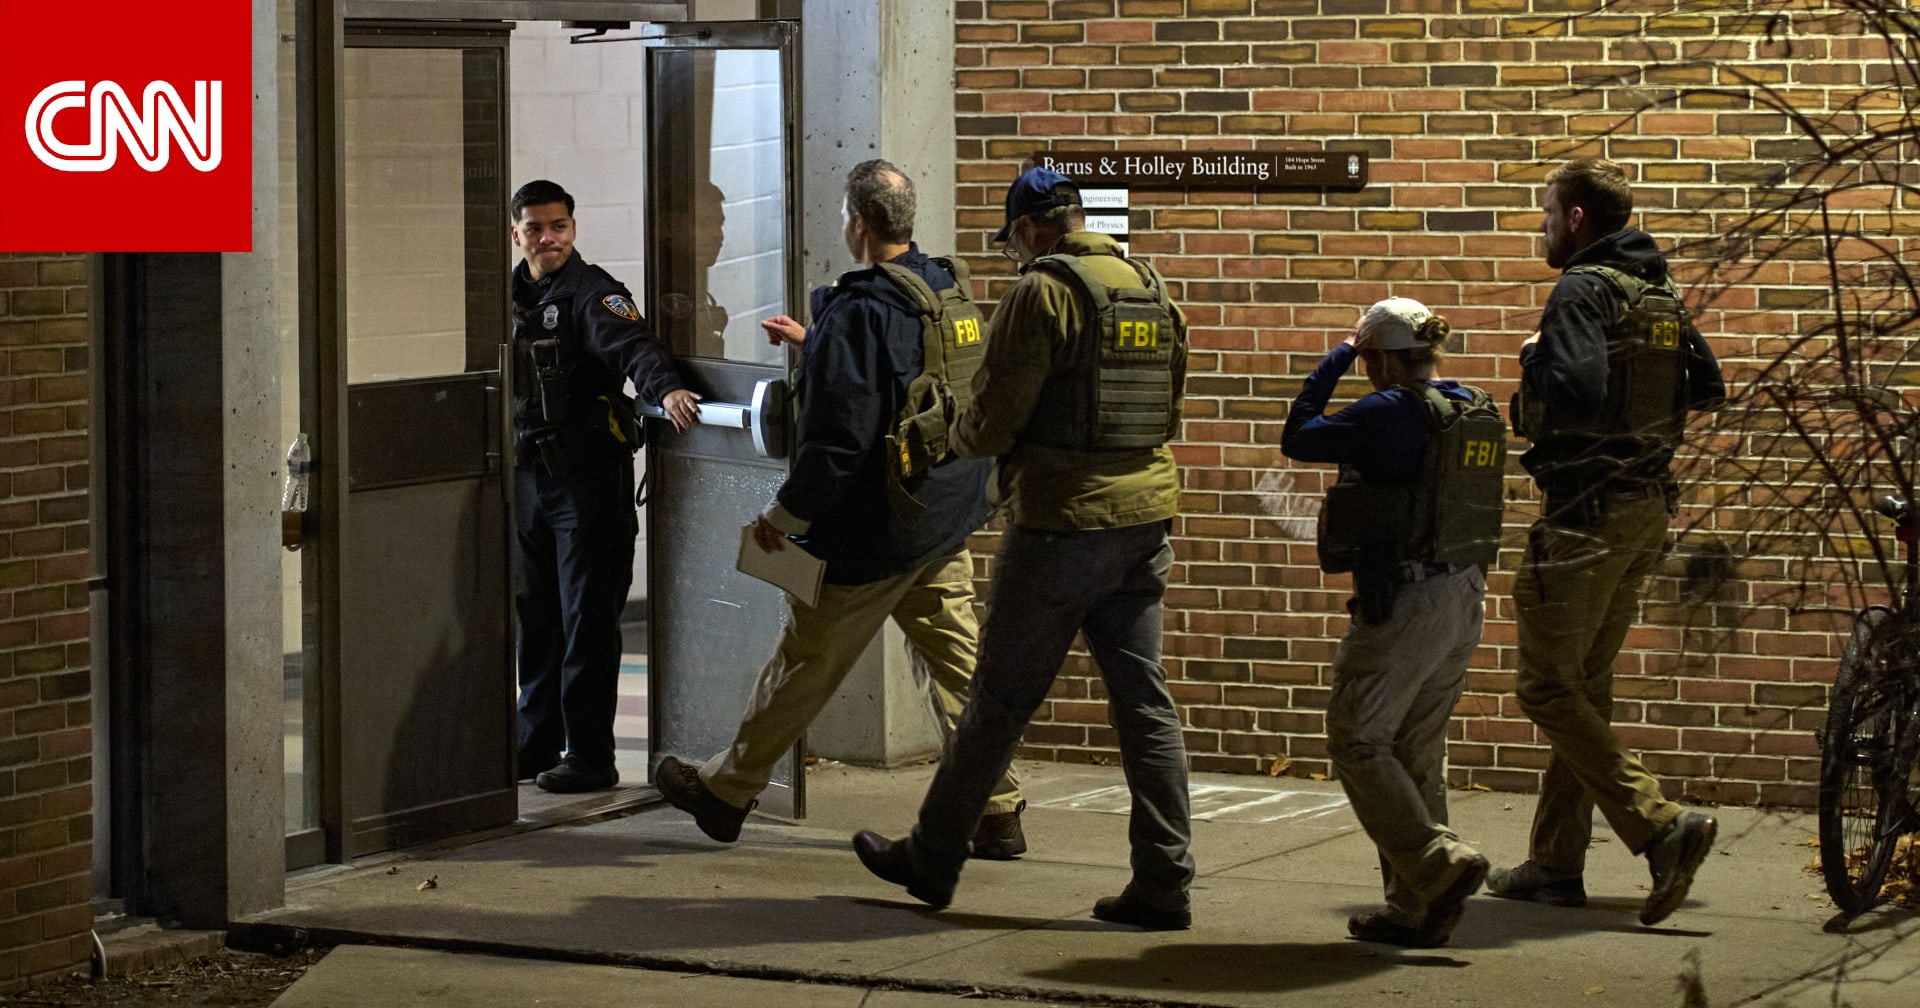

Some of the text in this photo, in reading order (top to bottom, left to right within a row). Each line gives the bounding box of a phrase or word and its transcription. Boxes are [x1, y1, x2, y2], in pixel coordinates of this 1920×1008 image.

[1043, 154, 1269, 180] Barus & Holley Building
[1083, 194, 1123, 203] ngineering
[1086, 220, 1124, 230] of Physics
[955, 318, 980, 344] FBI
[1119, 321, 1158, 347] FBI
[1653, 321, 1679, 347] FBI
[1464, 440, 1498, 467] FBI
